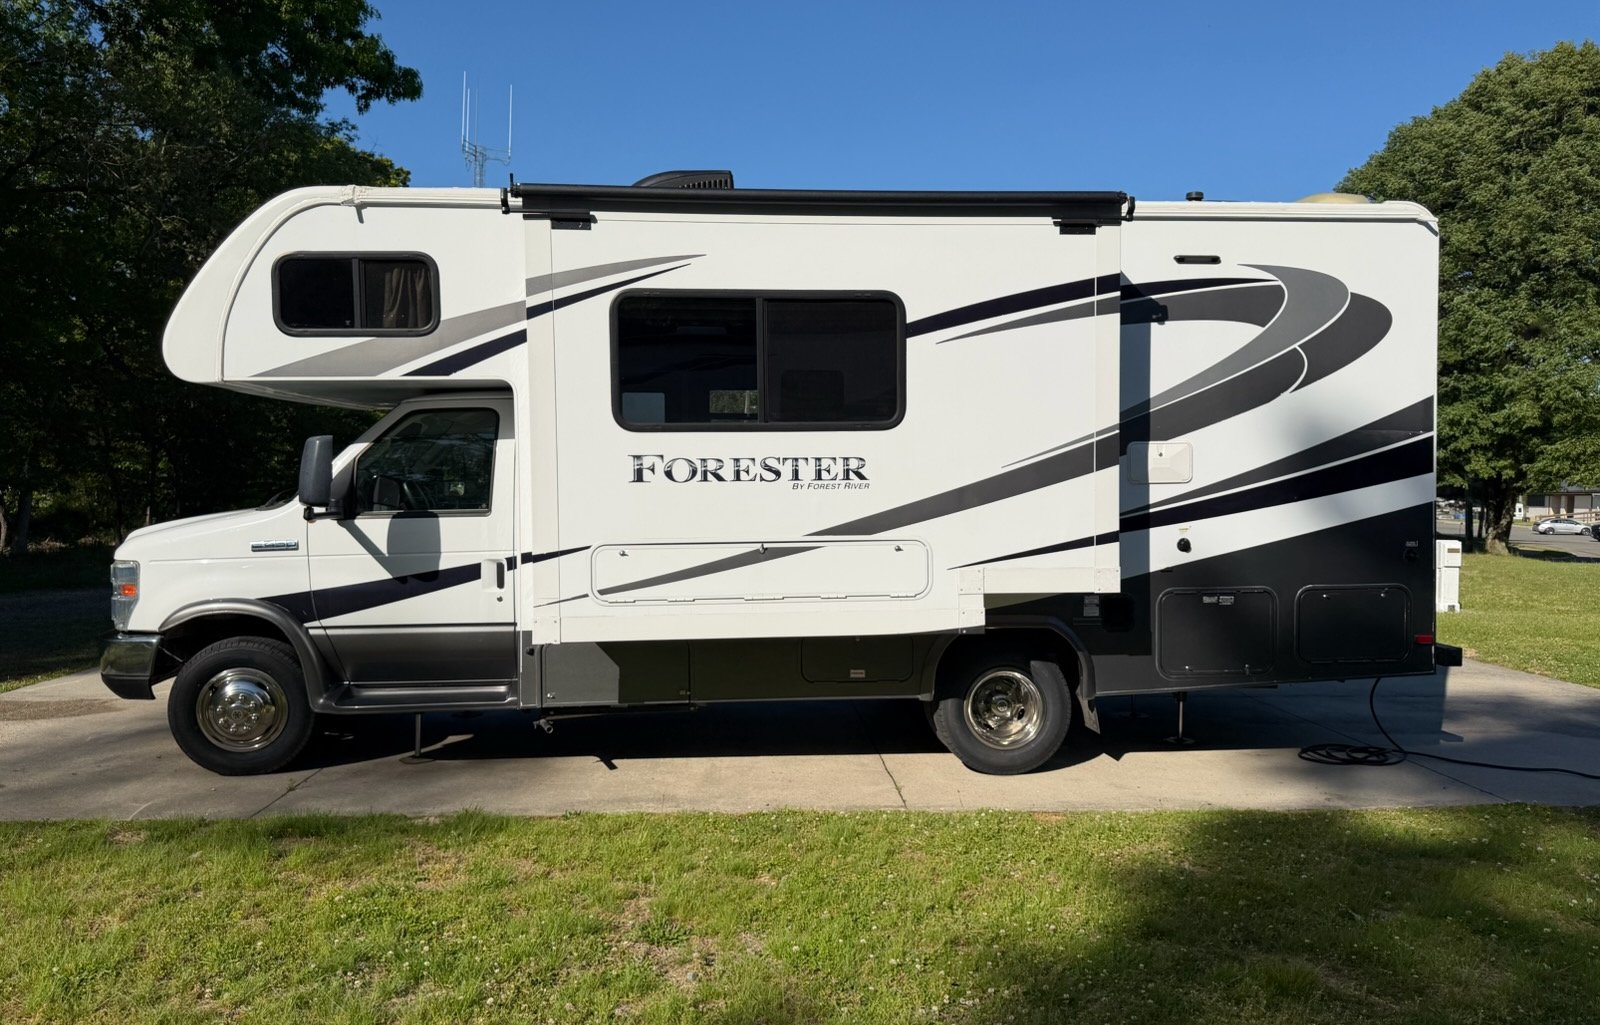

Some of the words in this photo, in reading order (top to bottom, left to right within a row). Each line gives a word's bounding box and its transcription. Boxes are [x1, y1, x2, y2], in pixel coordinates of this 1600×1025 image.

[628, 454, 870, 483] FORESTER
[792, 482, 805, 490] BY
[807, 482, 842, 490] FOREST
[844, 482, 870, 490] RIVER
